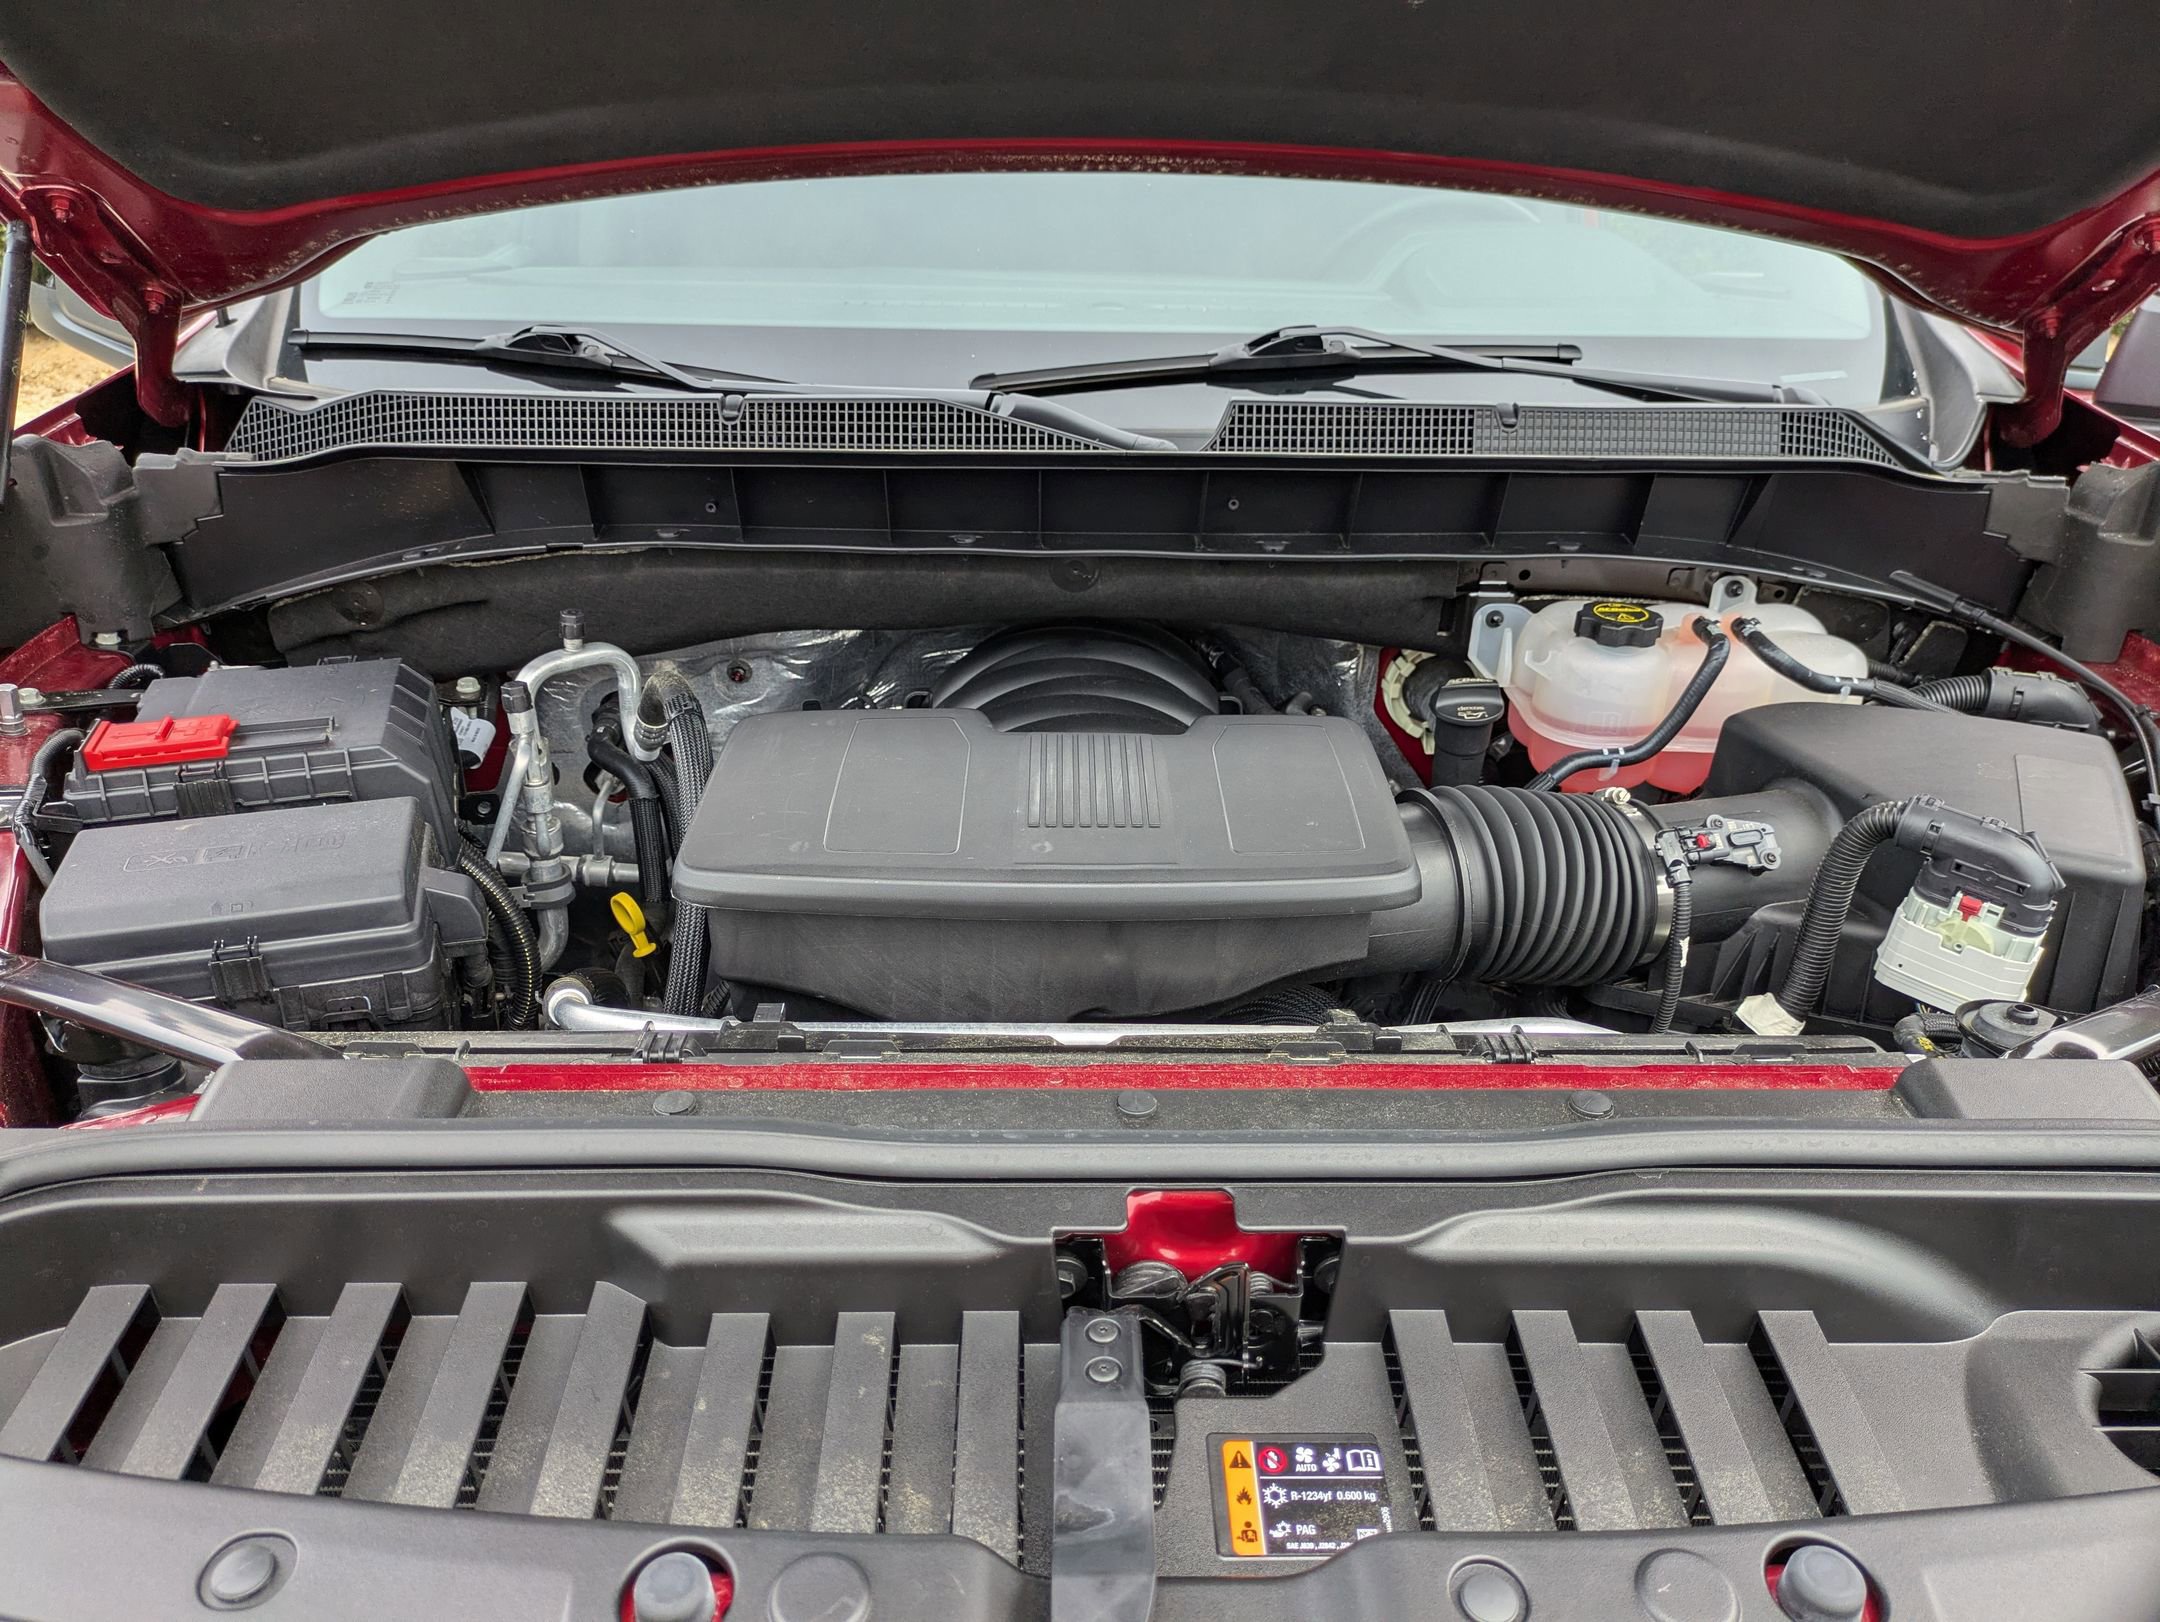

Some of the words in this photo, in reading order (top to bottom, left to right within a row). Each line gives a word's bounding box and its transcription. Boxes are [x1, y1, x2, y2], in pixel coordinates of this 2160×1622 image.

[1295, 1464, 1317, 1472] AUTO
[1291, 1491, 1332, 1502] R-1234yf
[1337, 1491, 1363, 1501] 0.600
[1364, 1491, 1377, 1503] kg
[1296, 1524, 1317, 1535] PAG
[1286, 1542, 1299, 1550] SAE
